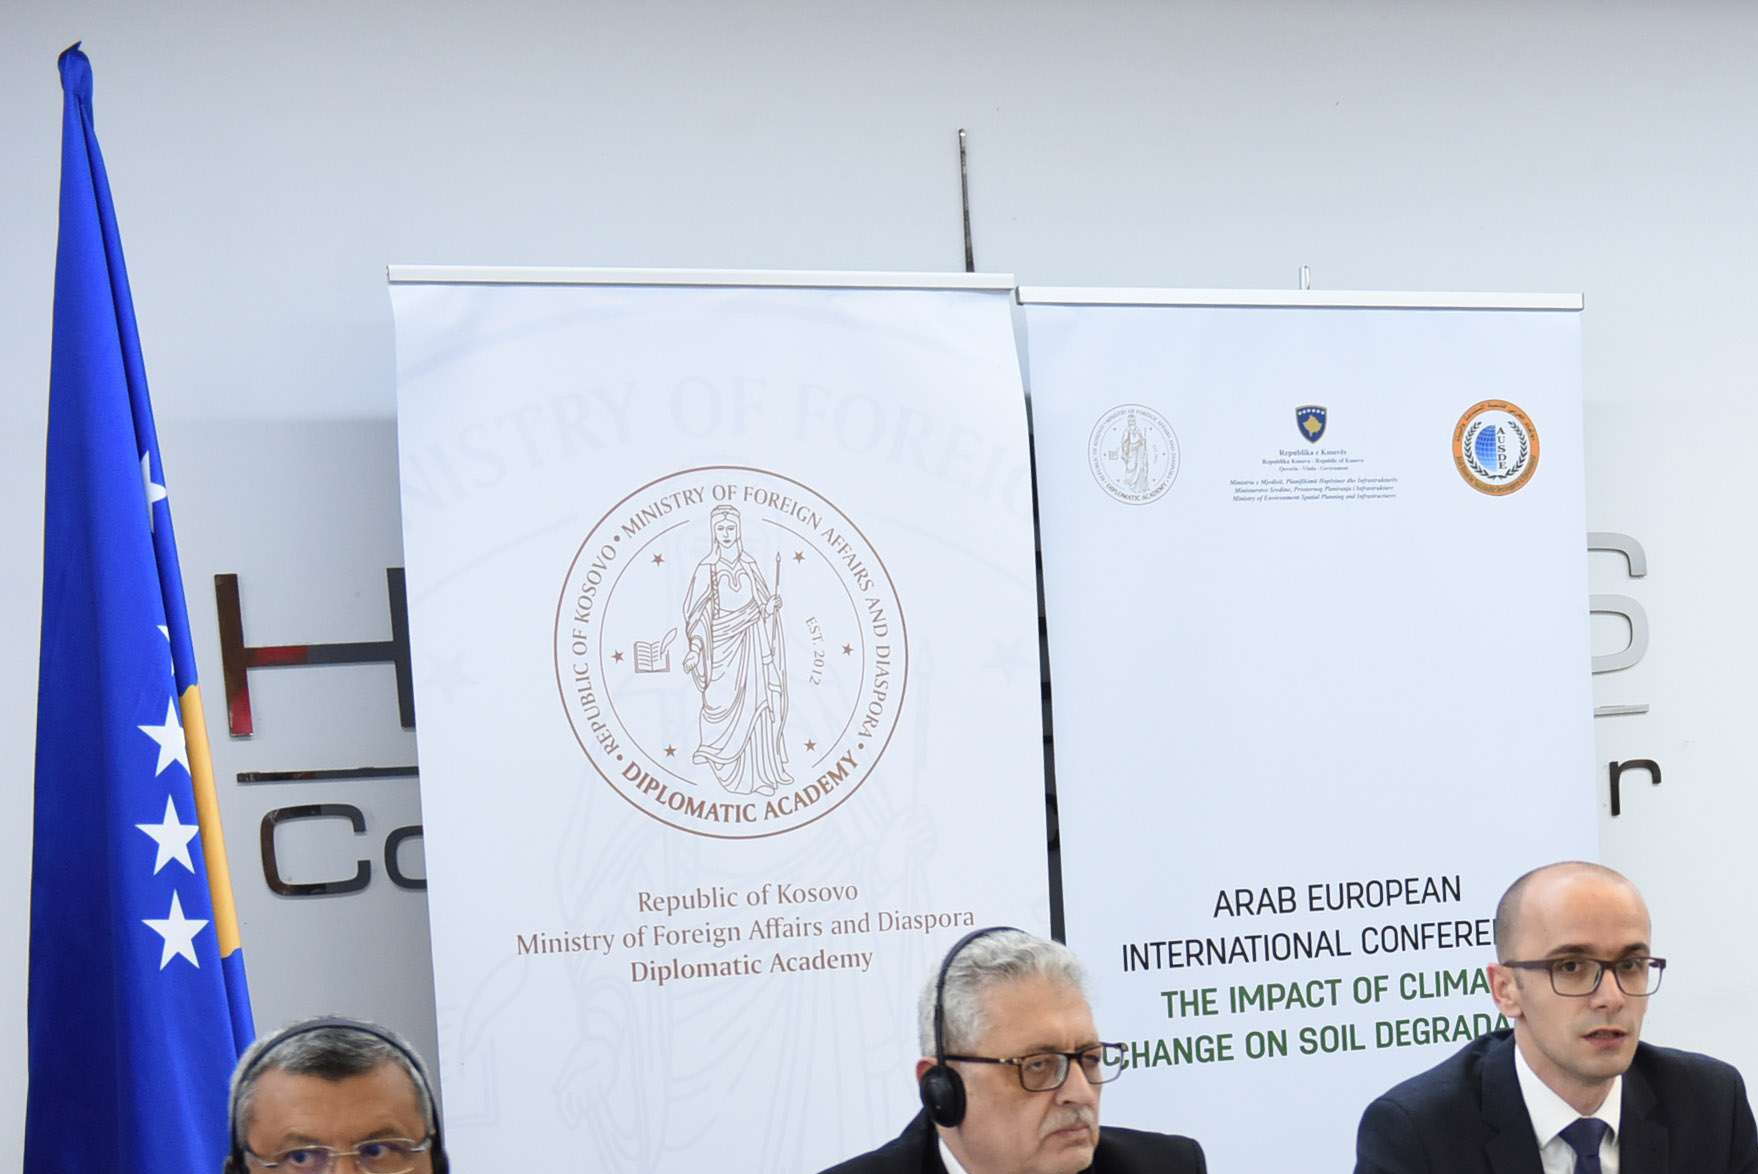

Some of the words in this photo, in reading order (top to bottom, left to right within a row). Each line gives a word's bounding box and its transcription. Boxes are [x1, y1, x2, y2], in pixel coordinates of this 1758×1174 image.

[621, 486, 705, 539] MINISTRY
[712, 484, 737, 501] OF
[743, 485, 822, 530] FOREIGN
[821, 527, 874, 592] AFFAIRS
[574, 544, 617, 624] KOSOVO
[865, 595, 888, 638] AND
[572, 628, 588, 656] OF
[808, 650, 826, 687] 2012
[857, 644, 891, 739] DIASPORA
[574, 662, 620, 757] REPUBLIC
[621, 761, 757, 824] DIPLOMATIC
[763, 749, 860, 821] ACADEMY
[638, 886, 738, 916] Republic
[746, 883, 771, 906] of
[777, 883, 858, 904] Kosovo
[1213, 886, 1297, 918] ARAB
[1308, 875, 1461, 912] EUROPEAN
[516, 933, 614, 956] Ministry
[622, 924, 647, 949] of
[653, 924, 741, 947] Foreign
[749, 916, 823, 940] Affairs
[831, 912, 870, 935] and
[878, 910, 975, 934] Diaspora
[1122, 929, 1351, 973] INTERNATIONAL
[1361, 918, 1497, 955] CONFERE
[630, 955, 762, 985] Diplomatic
[769, 950, 873, 974] Academy
[1161, 987, 1218, 1018] THE
[1229, 978, 1342, 1014] IMPACT
[1352, 975, 1389, 1004] OF
[1399, 967, 1490, 1001] CLIMA
[1102, 1033, 1234, 1070] CHANGE
[1245, 1029, 1288, 1059] ON
[1299, 1023, 1366, 1056] SOIL
